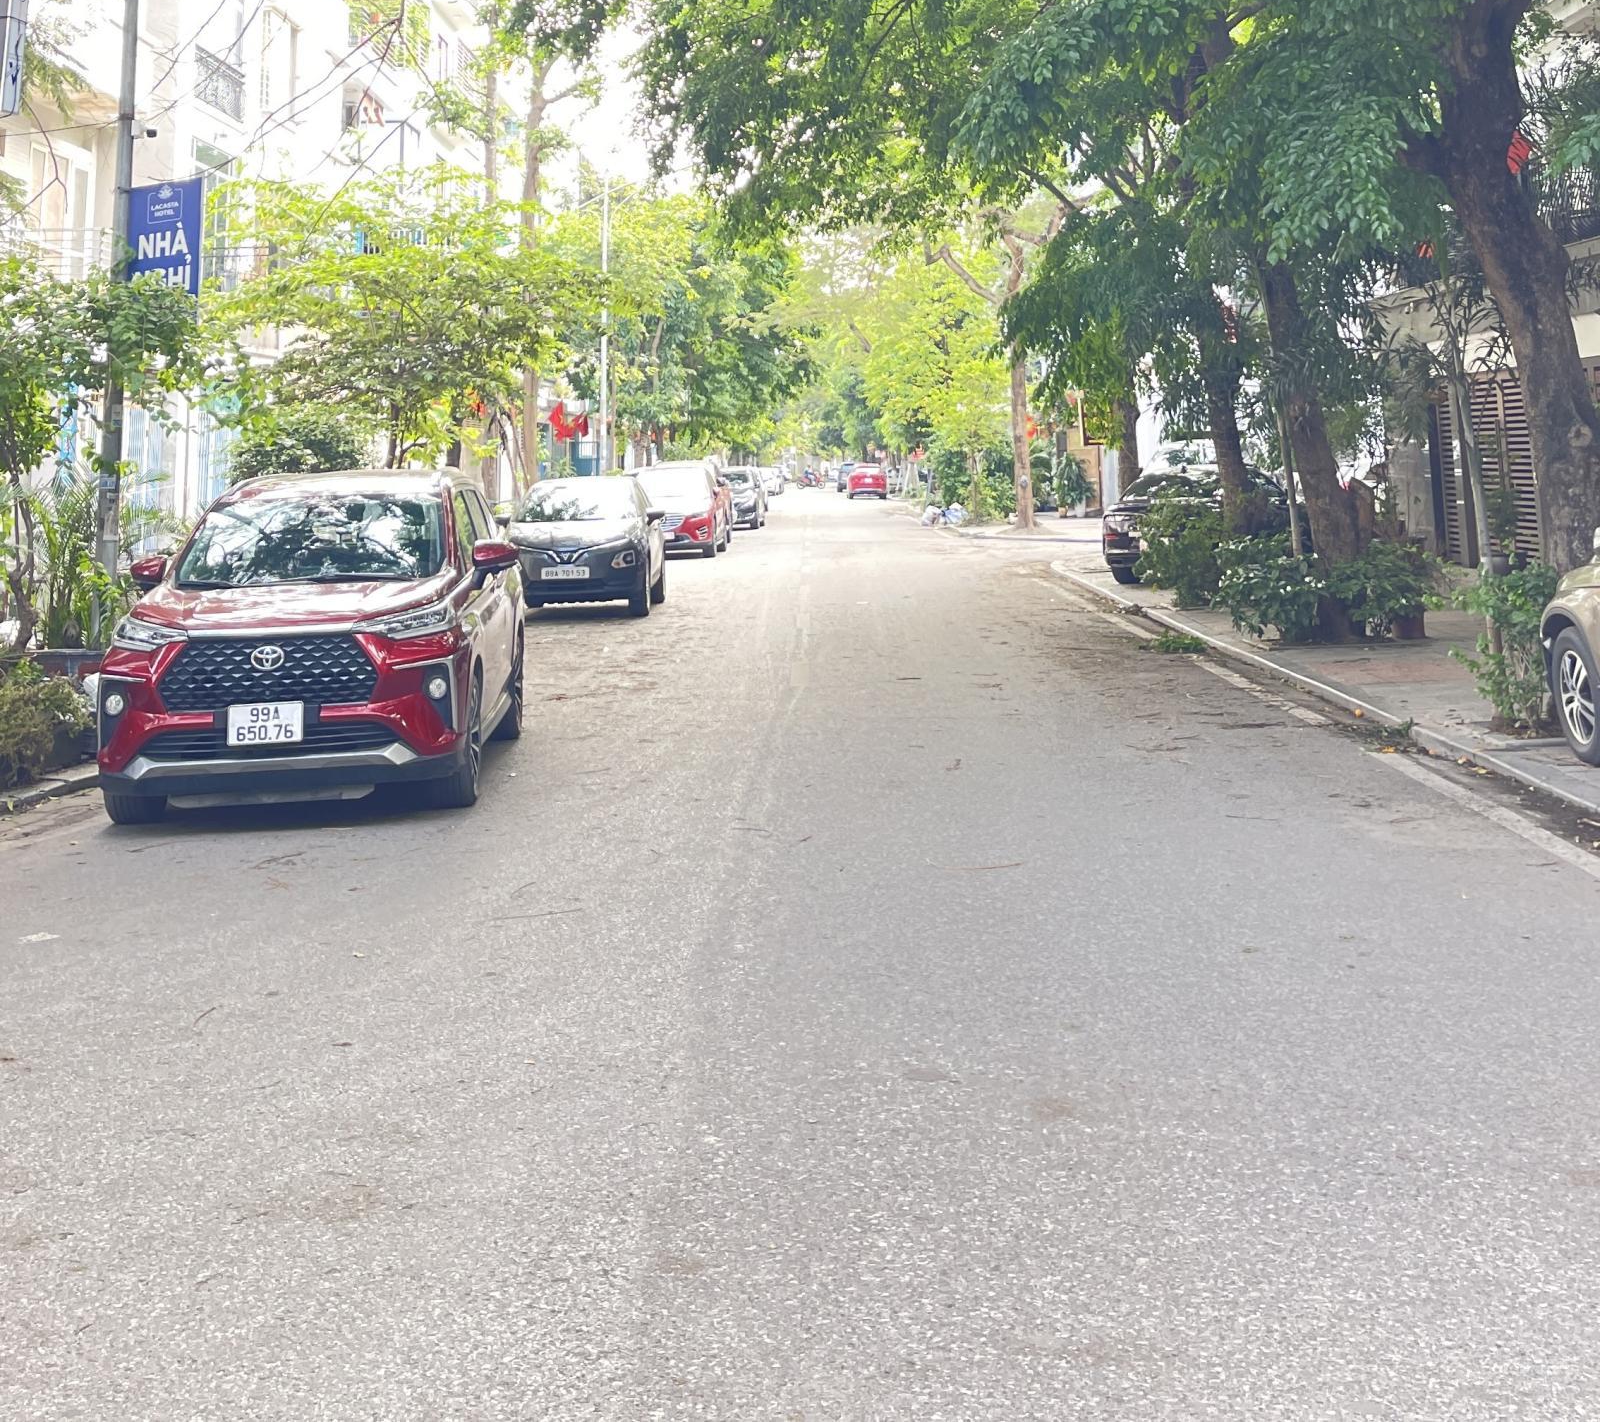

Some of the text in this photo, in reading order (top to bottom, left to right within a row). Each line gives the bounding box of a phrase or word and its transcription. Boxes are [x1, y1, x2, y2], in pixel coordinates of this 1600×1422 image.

[150, 201, 179, 211] LACASTA
[154, 208, 175, 217] HOTEL
[138, 221, 189, 260] NHÀ
[134, 254, 191, 291] GHỈ
[250, 706, 280, 723] 99A
[236, 723, 294, 742] 650.76
